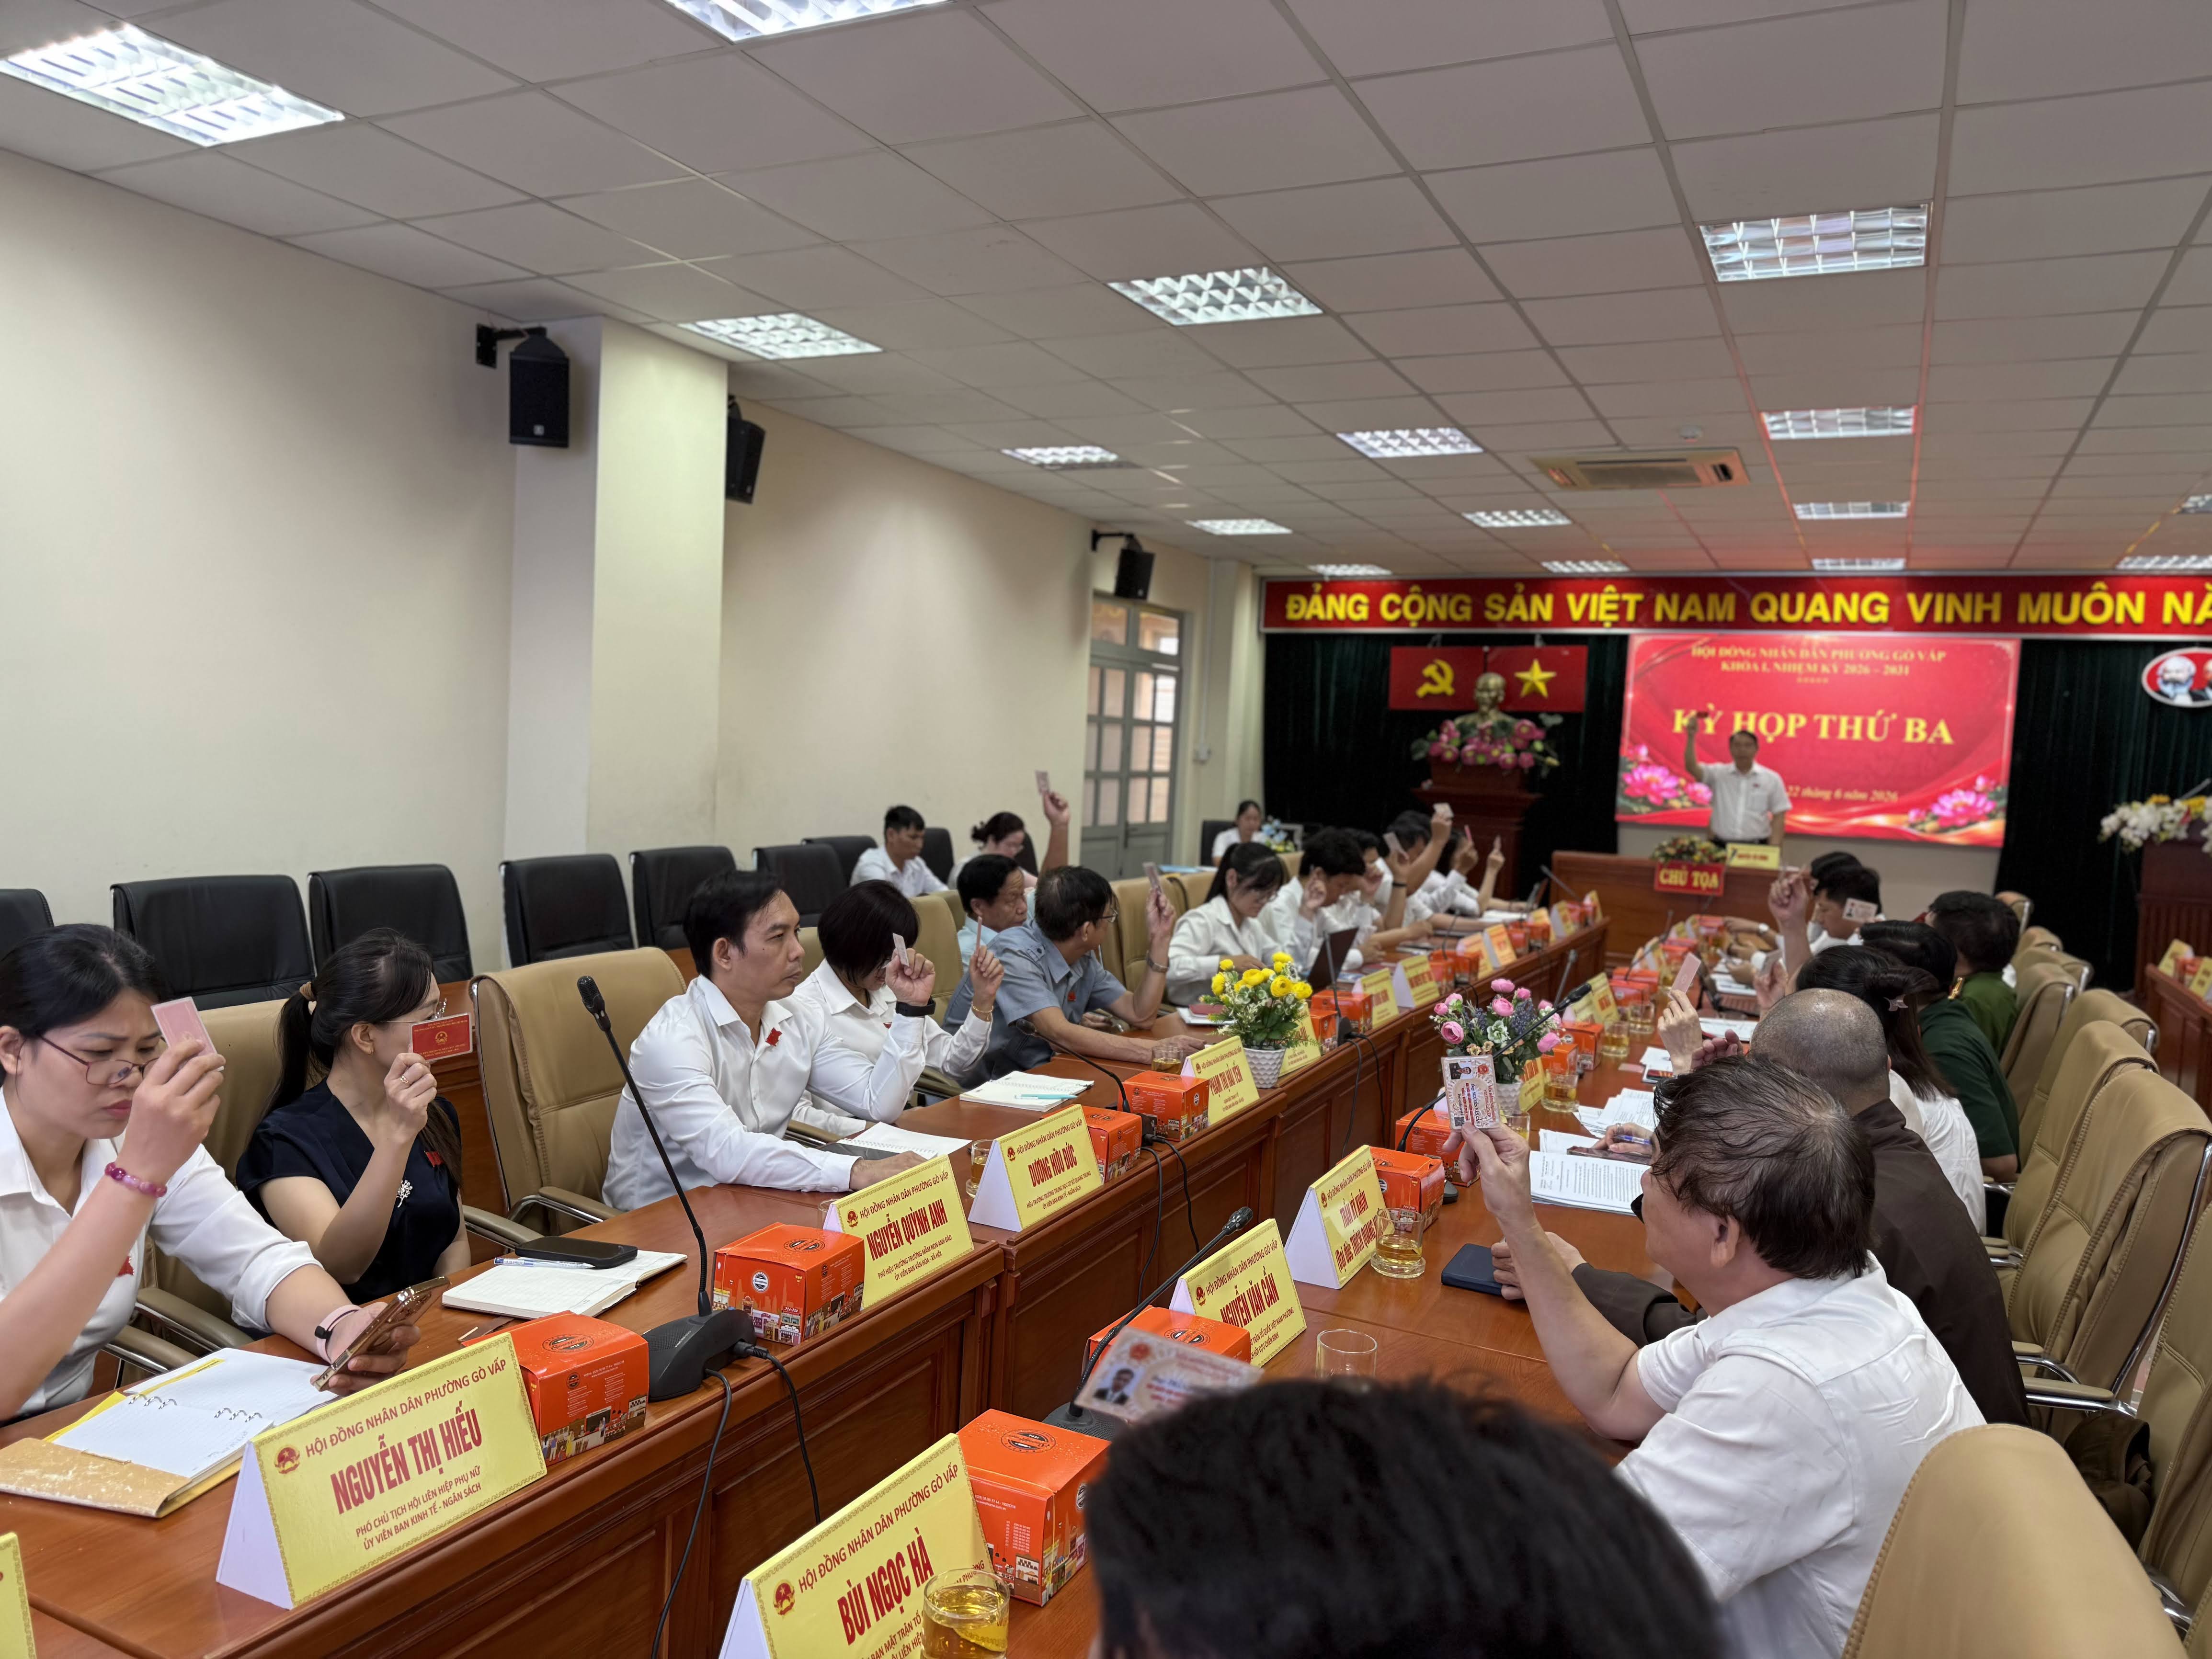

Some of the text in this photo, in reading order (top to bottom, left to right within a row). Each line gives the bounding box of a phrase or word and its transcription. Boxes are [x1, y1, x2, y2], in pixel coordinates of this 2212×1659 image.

[1286, 582, 1369, 621] ĐẢNG
[1380, 585, 1472, 627] CỘNG
[1485, 583, 1554, 622] SẢN
[1566, 584, 1644, 628] VIỆT
[1654, 592, 1736, 622] NAM
[1750, 591, 1890, 623] QUANG
[1907, 591, 2002, 623] VINH
[2017, 581, 2146, 625] MUÔN
[1691, 646, 1716, 659] HỘI
[1673, 702, 1955, 745] KỲ HỌP THỨ BA
[1219, 1071, 1230, 1092] THỊ
[1024, 1140, 1036, 1151] ĐỒNG
[1036, 1135, 1047, 1145] NHÂN
[1047, 1131, 1055, 1140] DÂN
[1055, 1124, 1070, 1136] PHƯỜNG
[1070, 1121, 1076, 1129] GÒ
[1028, 1141, 1077, 1188] DƯƠNG HỮU ĐỨC
[860, 1171, 948, 1219] HỘI ĐỒNG NHÂN DÂN PHƯỜNG GÒ VẤP
[866, 1198, 948, 1261] NGUYỄN QUỲNH ANH
[1350, 1229, 1365, 1256] THÍCH
[1361, 1219, 1376, 1248] QUANG
[878, 1269, 886, 1279] PHÓ
[885, 1266, 894, 1275] HIỆU
[922, 1246, 931, 1255] MẦM
[895, 1272, 900, 1281] ỦY
[900, 1269, 908, 1278] VIÊN
[1206, 1283, 1214, 1295] HỘI
[1214, 1273, 1227, 1290] ĐỒNG
[1227, 1266, 1239, 1281] NHÂN
[1238, 1260, 1248, 1273] DÂN
[1247, 1249, 1265, 1268] PHƯỜNG
[1264, 1245, 1271, 1256] GÒ
[1246, 1280, 1266, 1318] VĂN
[1261, 1266, 1280, 1308] CẨN
[306, 1357, 506, 1457] HỘI ĐỒNG NHÂN DÂN PHƯỜNG GÒ VẤP
[331, 1400, 482, 1515] NGUYỄN THỊ HIẾU
[355, 1465, 481, 1537] PHÓ CHỦ TỊCH HỘI LIÊN HIỆP PHỤ NỮ
[364, 1482, 481, 1550] ỦY VIÊN BAN KINH TẾ NGÂN SÁCH
[798, 1462, 958, 1593] HỘI ĐỒNG NHÂN DÂN PHƯỜNG GÒ VẤP
[837, 1579, 872, 1646] BÙI
[866, 1552, 911, 1623] NGỌC
[906, 1527, 935, 1588] HÀ
[884, 1610, 922, 1653] MẶT TRẬN TỔ
[899, 1643, 912, 1659] LIÊN
